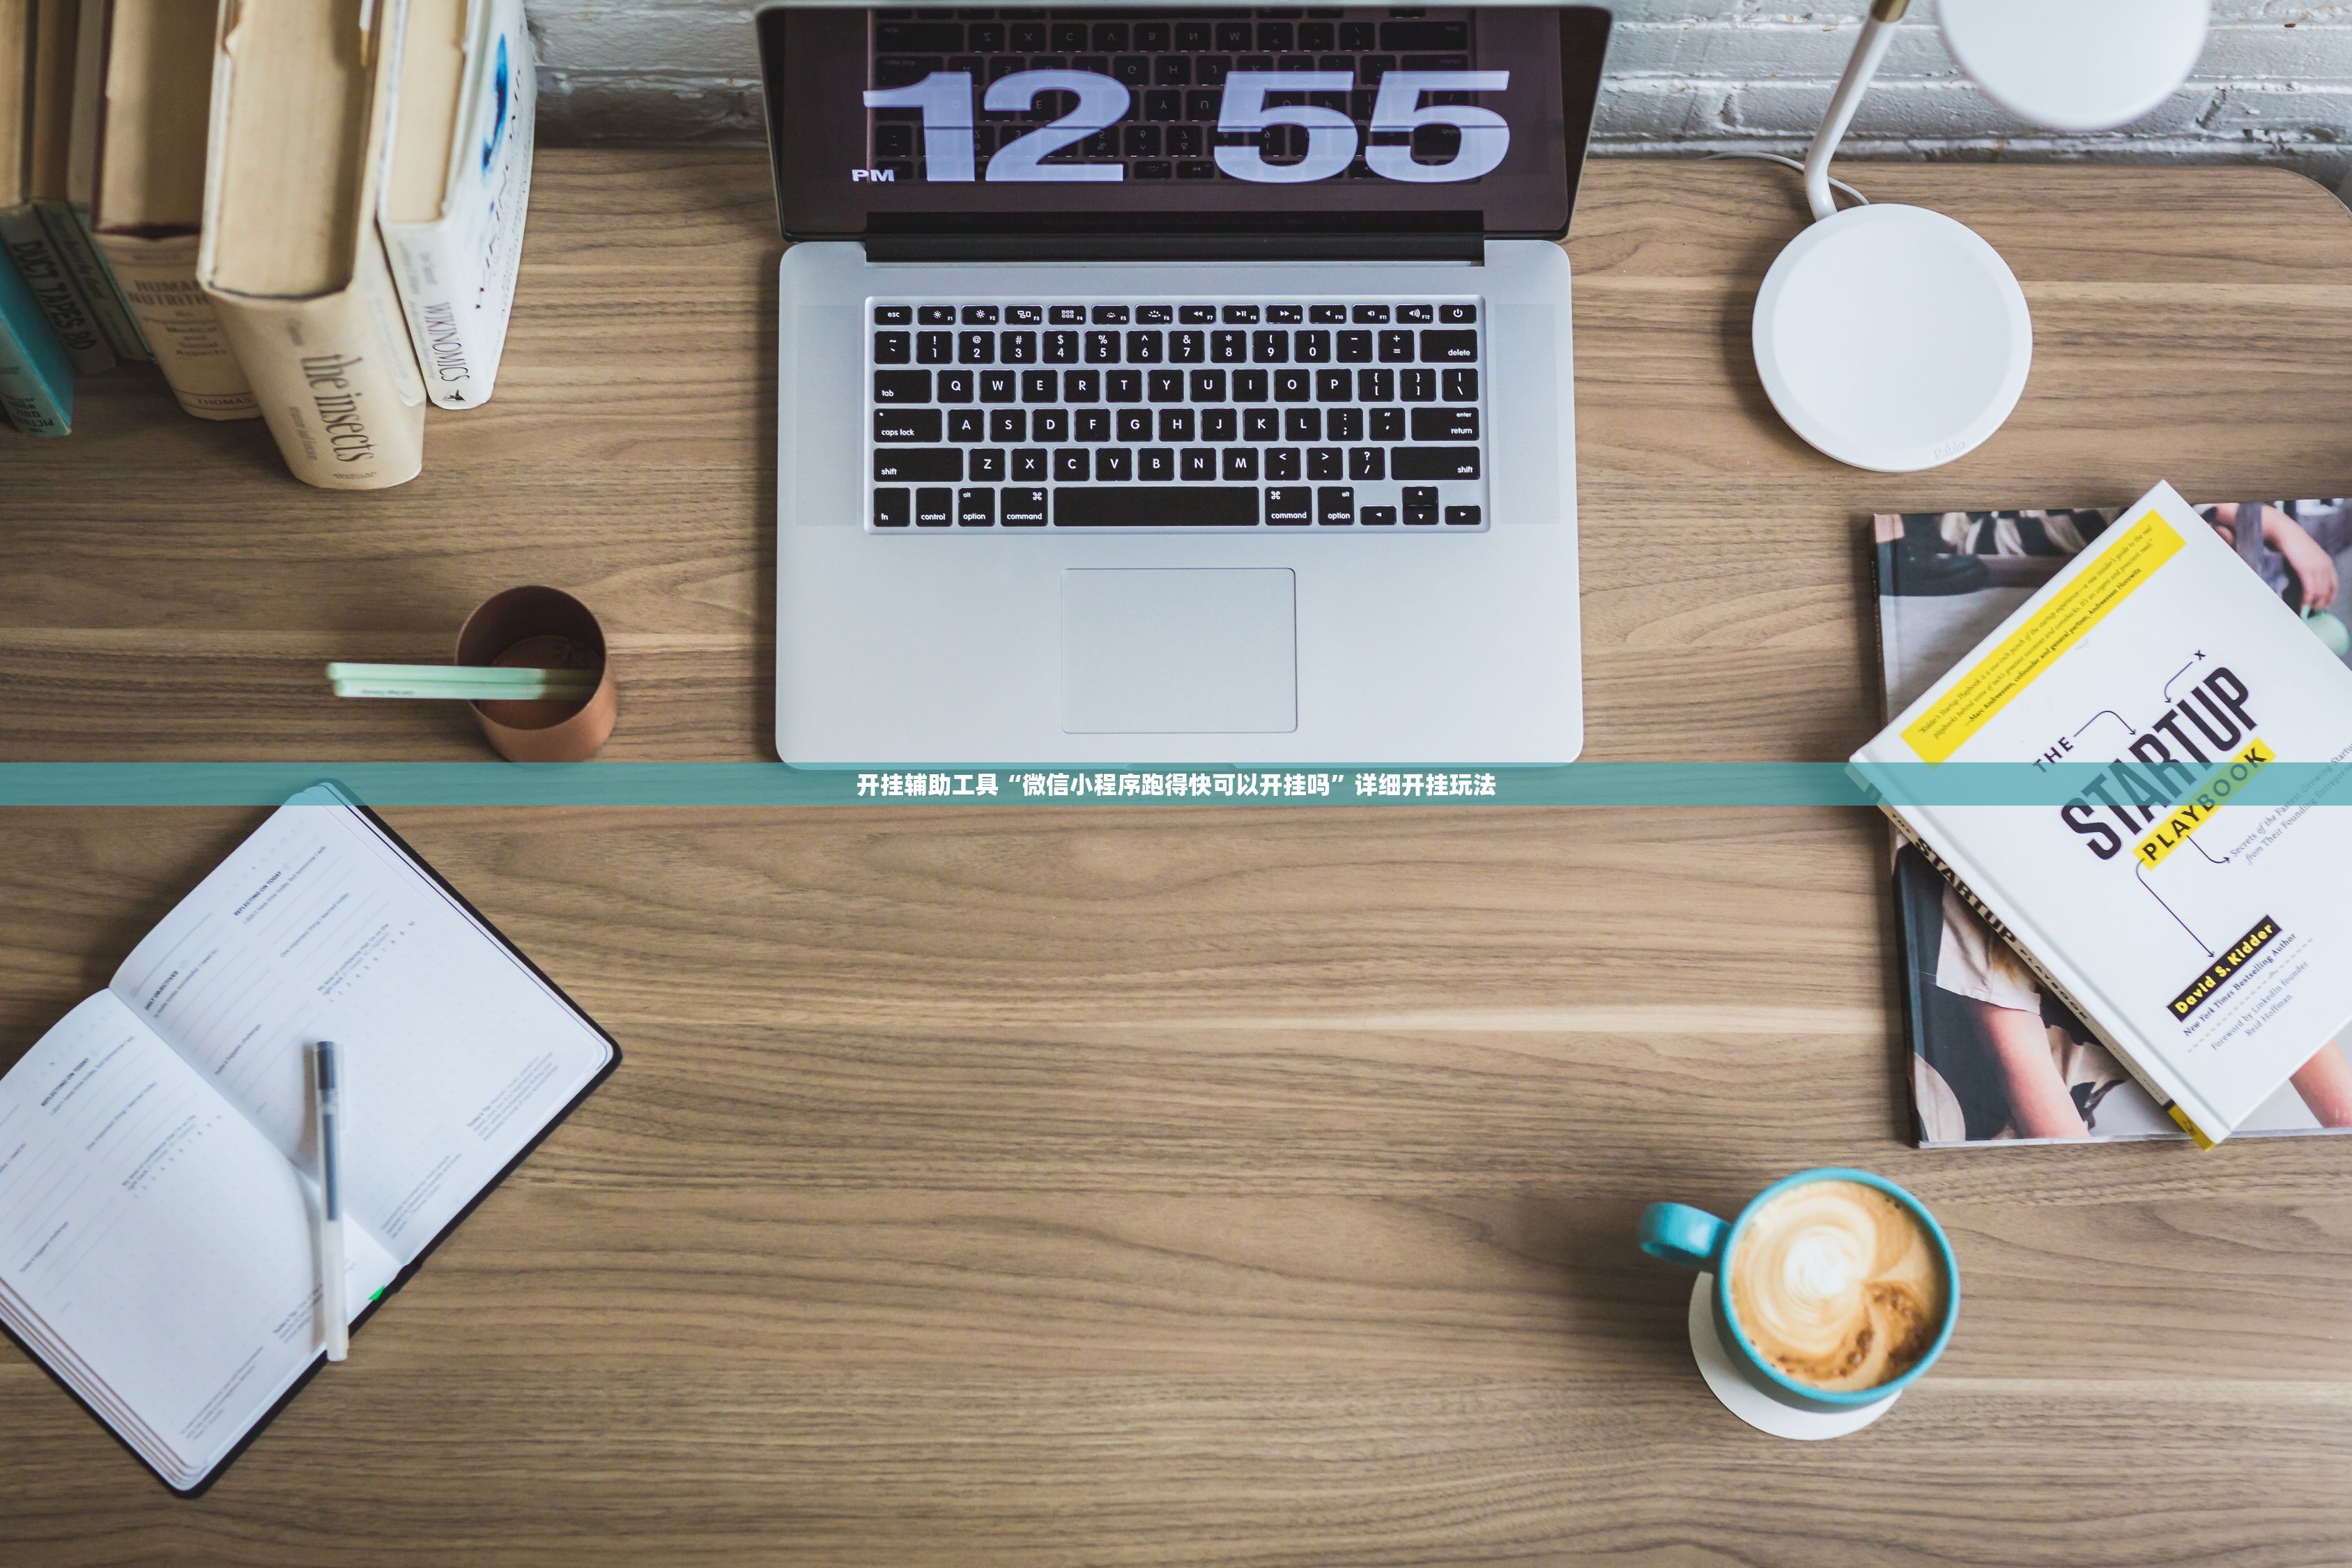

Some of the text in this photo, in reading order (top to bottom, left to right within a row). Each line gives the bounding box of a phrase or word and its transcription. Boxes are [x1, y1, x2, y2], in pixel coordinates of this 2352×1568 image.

[852, 69, 1511, 183] PM 12 55
[424, 301, 470, 383] WIKINOMICS
[932, 348, 937, 358] 1
[974, 348, 981, 358] 2
[1015, 348, 1022, 358] 3
[1056, 348, 1064, 358] 4
[1100, 347, 1107, 358] 5
[1142, 347, 1148, 358] 6
[1183, 347, 1190, 357] 7
[1225, 347, 1233, 357] 8
[1267, 347, 1275, 357] 9
[1309, 346, 1316, 357] 0
[300, 354, 363, 390] the
[951, 381, 961, 391] Q
[992, 381, 1004, 391] W
[1036, 380, 1043, 391] E
[1079, 380, 1086, 391] R
[1121, 380, 1128, 390] T
[1162, 380, 1171, 390] Y
[1204, 379, 1213, 390] U
[1287, 379, 1297, 390] O
[1330, 379, 1339, 390] P
[197, 397, 252, 406] THOMAS
[314, 392, 378, 462] insects
[962, 420, 971, 430] A
[1005, 420, 1013, 430] S
[1046, 419, 1055, 430] D
[1089, 419, 1096, 430] F
[1130, 419, 1140, 430] G
[1173, 419, 1182, 429] H
[1215, 419, 1222, 429] J
[1257, 418, 1266, 429] K
[1300, 418, 1307, 429] L
[983, 459, 992, 470] Z
[1025, 459, 1035, 469] X
[1068, 459, 1077, 469] C
[1109, 459, 1119, 469] V
[1153, 458, 1160, 469] B
[1194, 458, 1204, 469] N
[1235, 457, 1247, 468] M
[962, 512, 986, 521] option
[1328, 512, 1351, 521] option
[2013, 657, 2040, 682] cofounder
[2039, 648, 2050, 659] and
[2049, 631, 2070, 651] general
[2116, 567, 2141, 590] Horowitz
[1939, 698, 1959, 716] Startup
[1958, 678, 1981, 700] Playbook
[2033, 737, 2075, 773] THE
[2061, 667, 2258, 861] STARTUP
[2142, 747, 2268, 862] PLAYBOOK
[2230, 832, 2257, 857] Secrets
[2257, 822, 2268, 834] of
[2265, 813, 2277, 825] the
[2245, 845, 2264, 866] from
[2262, 828, 2284, 848] Their
[233, 890, 260, 916] REFLECTING
[266, 870, 282, 885] TODAY
[1916, 837, 2017, 943] STARTUP
[2174, 923, 2274, 1014] David S. Kidder
[2183, 932, 2297, 1036] New York Times Bestselling Author
[2211, 1020, 2244, 1050] Foreword
[2243, 1011, 2253, 1022] by
[2280, 960, 2308, 986] founder
[2245, 992, 2292, 1036] Reid Hoffman
